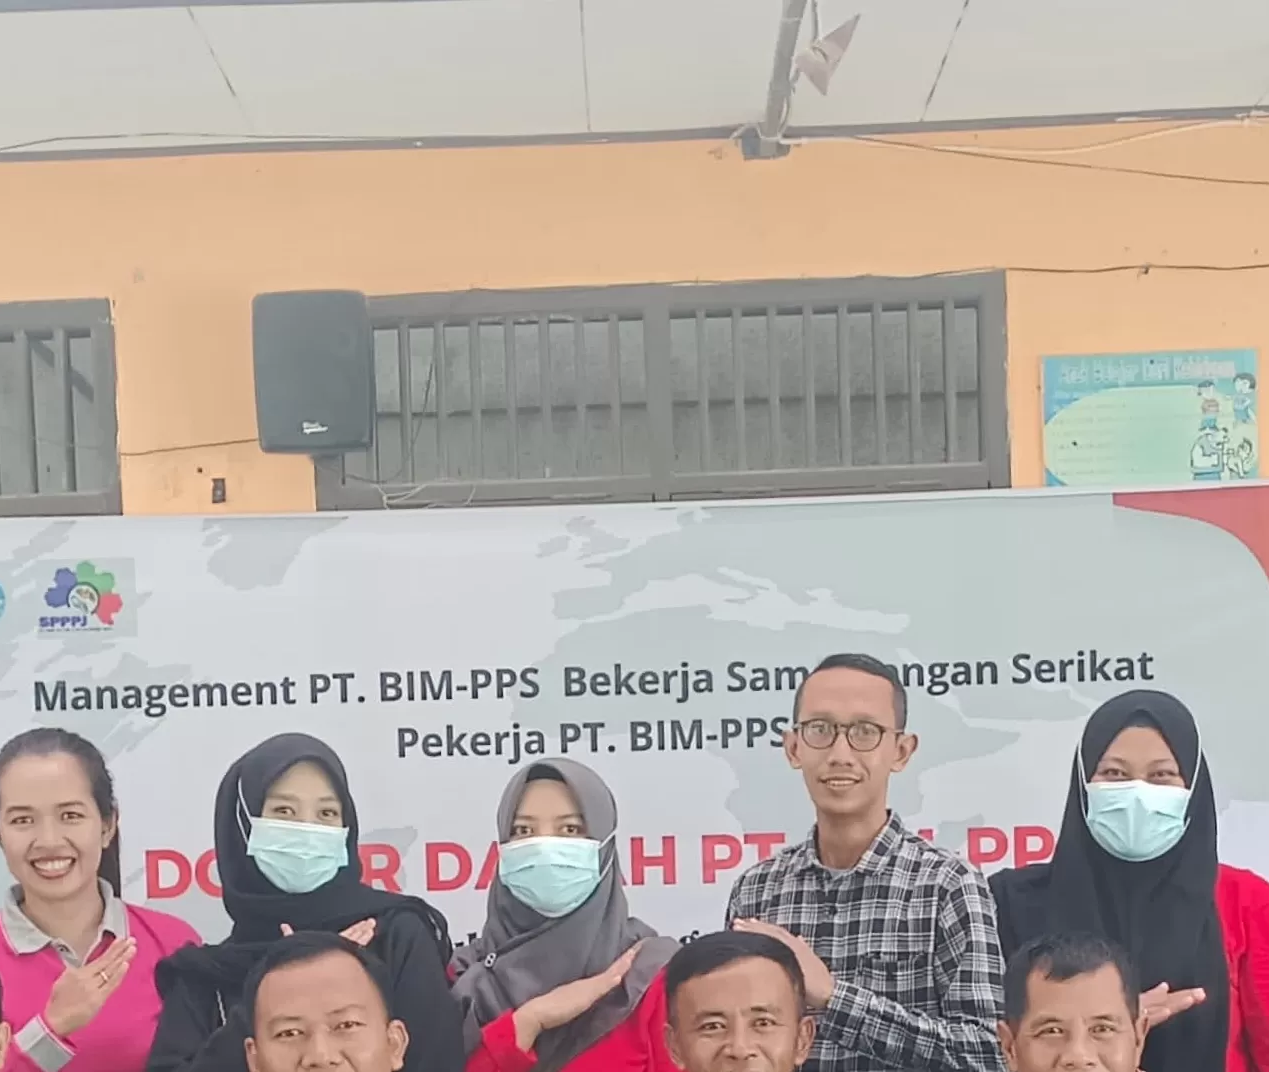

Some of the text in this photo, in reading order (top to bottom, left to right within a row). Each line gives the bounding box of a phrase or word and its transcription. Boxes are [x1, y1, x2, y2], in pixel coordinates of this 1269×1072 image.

[34, 650, 1155, 717] Management PT. BIM-PPS Bekerja Sam ngan Serikat
[397, 716, 788, 764] Pekerja PT. BIM-PPS
